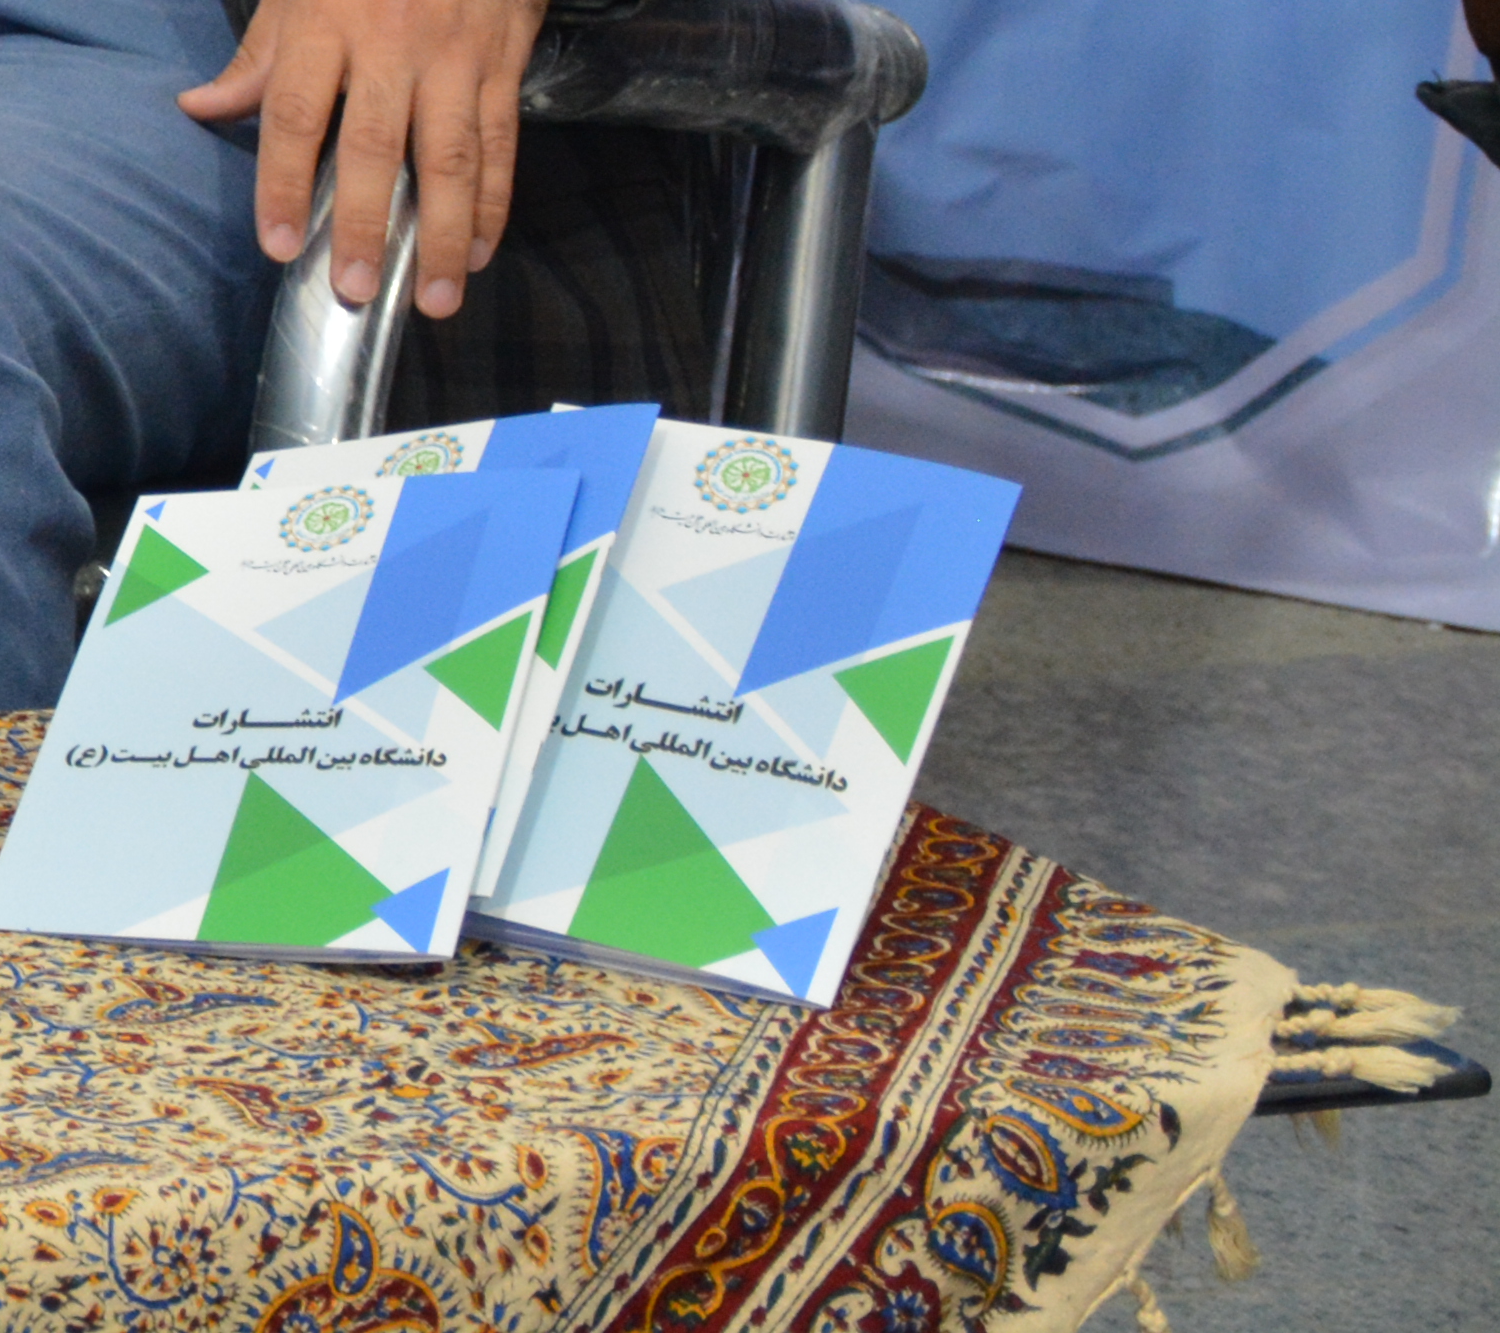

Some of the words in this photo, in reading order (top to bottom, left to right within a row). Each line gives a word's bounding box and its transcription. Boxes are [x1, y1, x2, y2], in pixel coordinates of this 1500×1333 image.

[585, 677, 744, 724] انتشارات
[193, 706, 343, 735] انتشارات
[561, 714, 633, 742] اهل
[66, 744, 109, 769] (ع)
[174, 745, 240, 768] اهل
[239, 745, 315, 770] المللی
[316, 746, 356, 770] بین
[360, 745, 447, 768] دانشگاه
[630, 731, 712, 760] المللی
[111, 748, 172, 769] بیت
[709, 749, 753, 775] بین
[756, 756, 848, 792] دانشگاه
